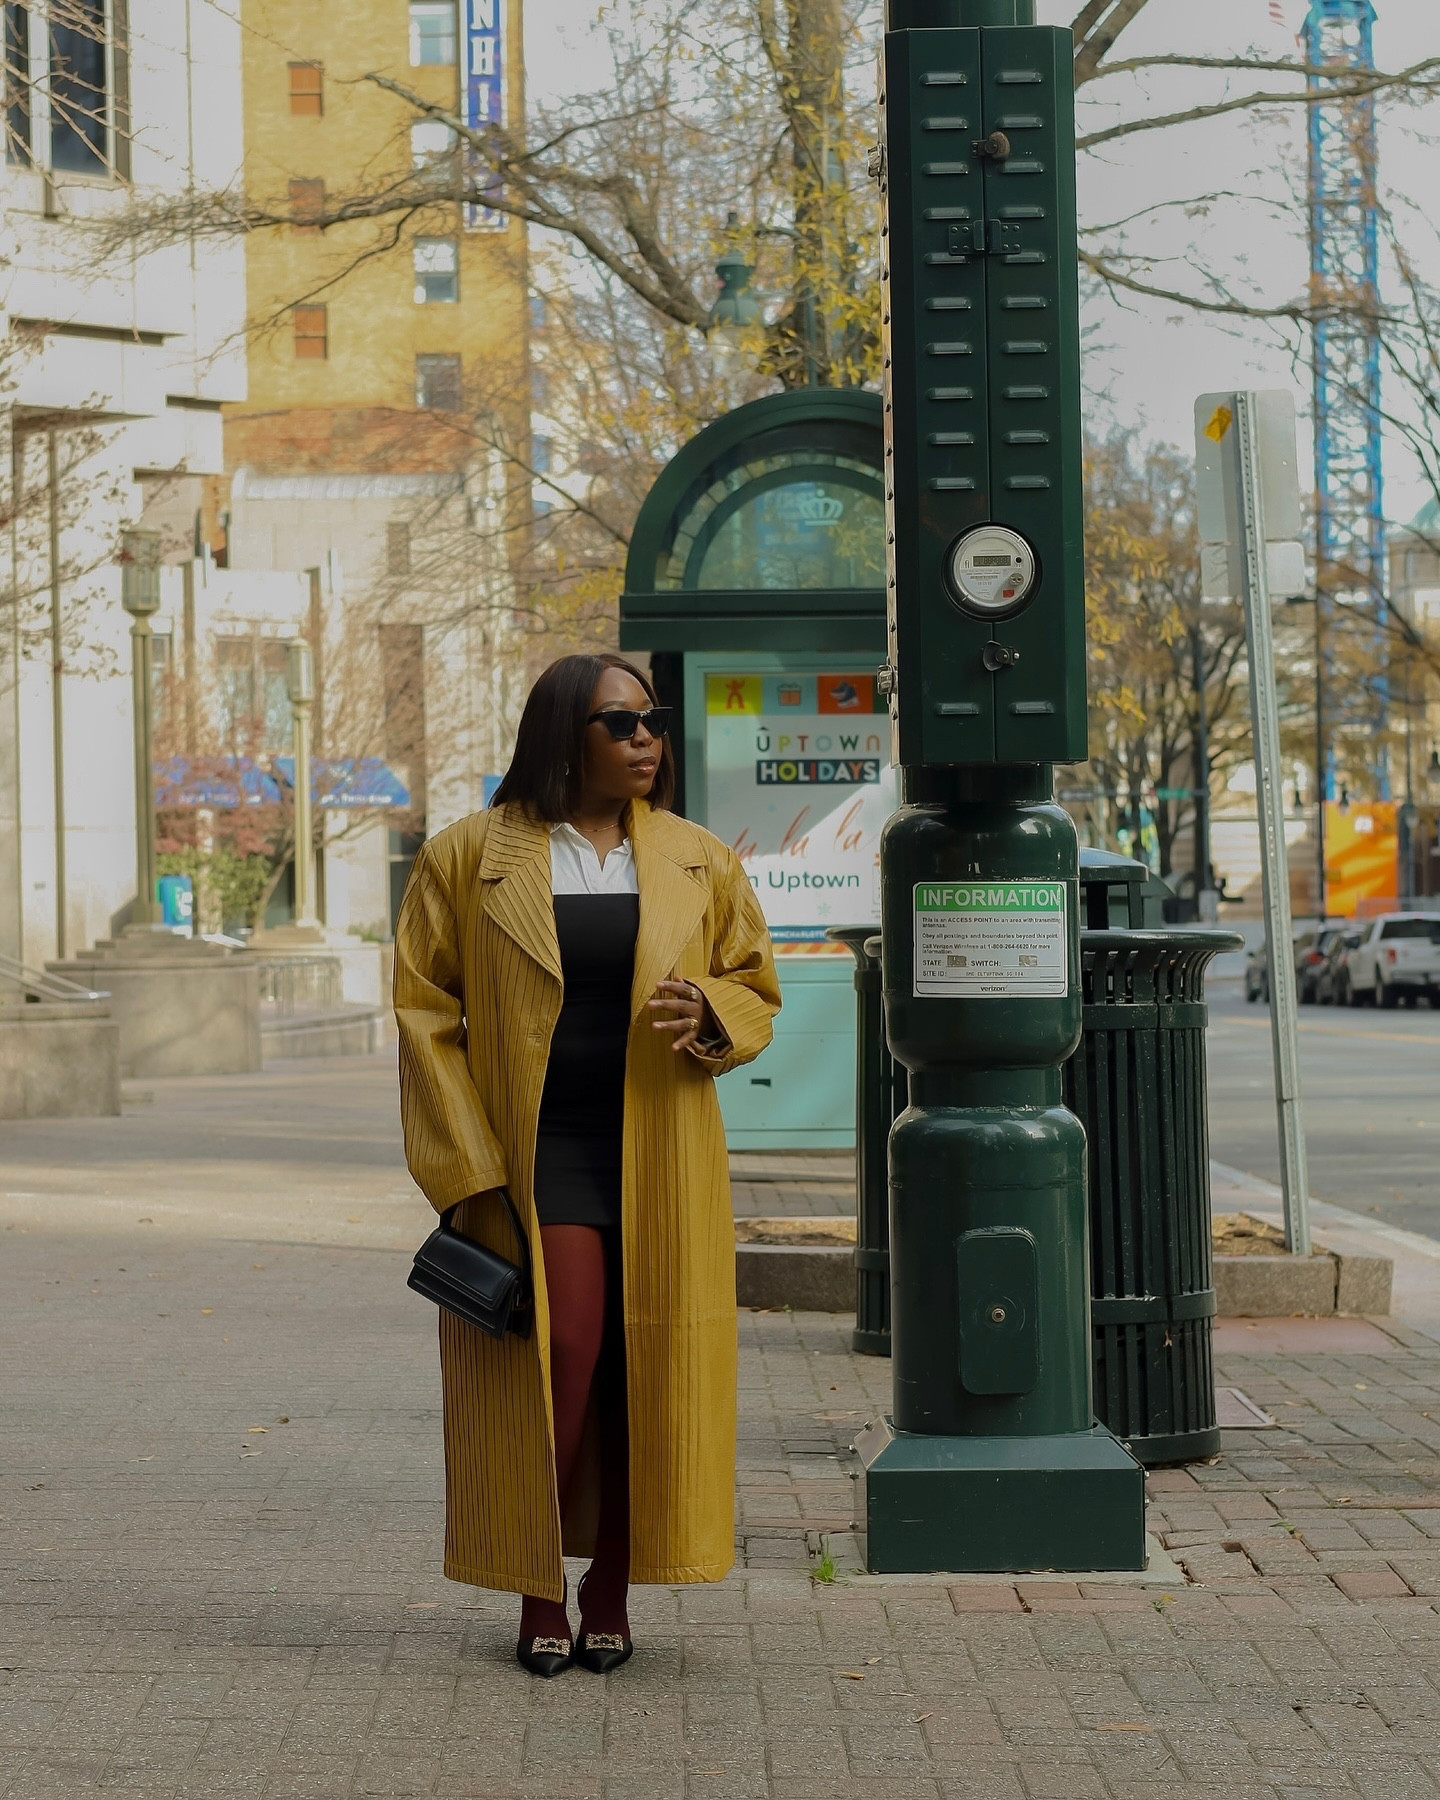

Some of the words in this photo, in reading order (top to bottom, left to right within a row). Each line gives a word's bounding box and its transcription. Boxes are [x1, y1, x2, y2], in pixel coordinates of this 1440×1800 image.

[760, 761, 877, 781] HOLIDAYS
[779, 804, 809, 857] la
[834, 799, 863, 851] la
[769, 871, 860, 893] Uptown
[922, 888, 1060, 906] INFORMATION
